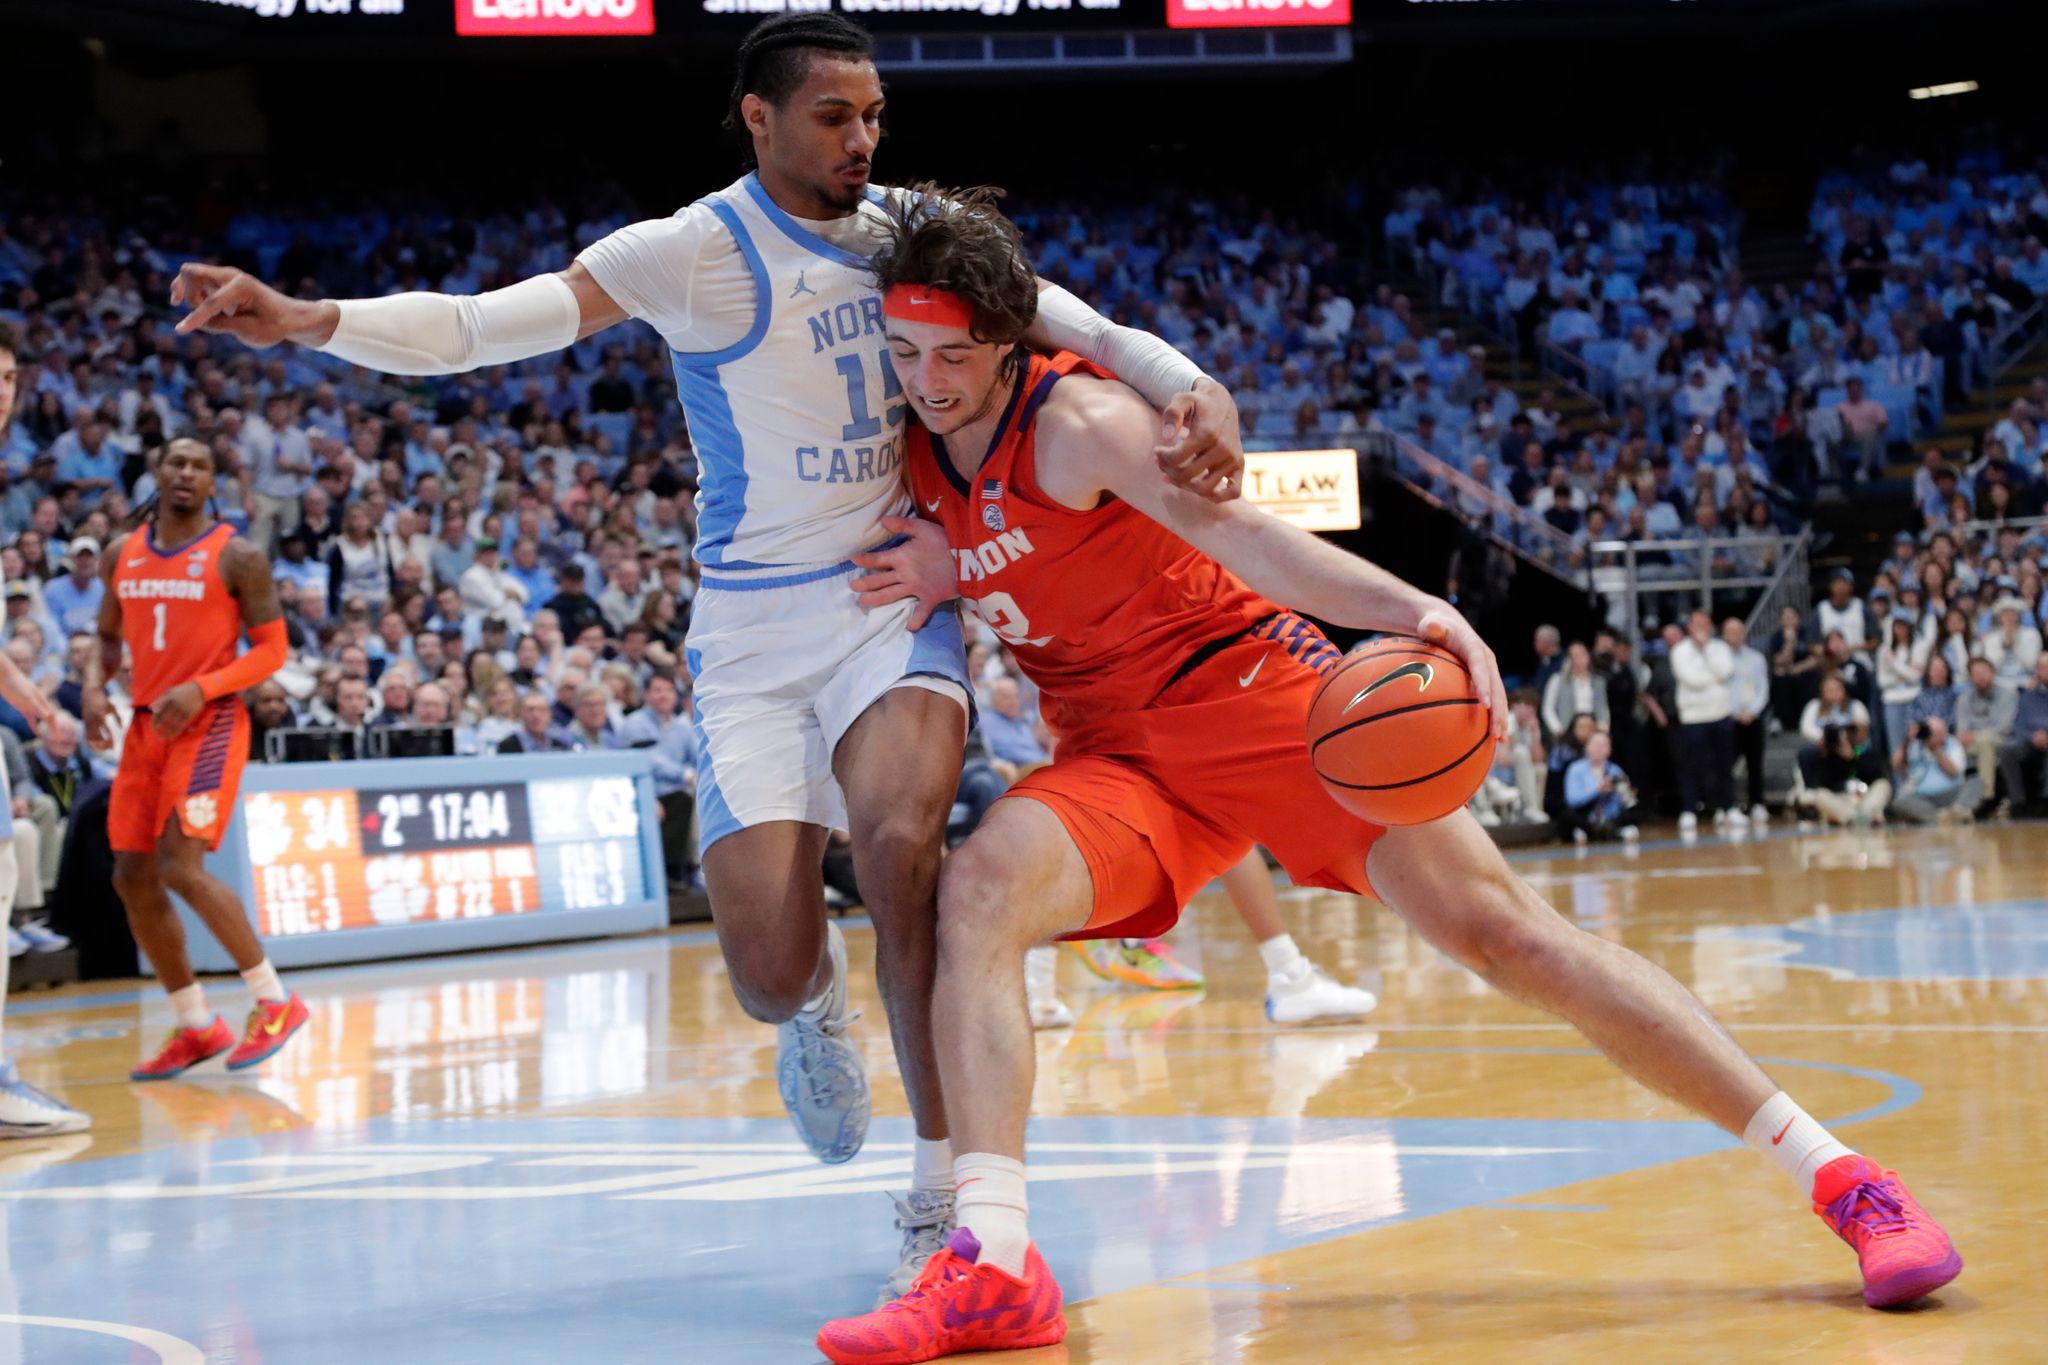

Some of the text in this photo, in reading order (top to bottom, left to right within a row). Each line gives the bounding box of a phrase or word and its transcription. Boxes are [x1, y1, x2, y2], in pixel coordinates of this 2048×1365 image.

[807, 296, 886, 354] NOR
[795, 437, 902, 484] CAROL
[1277, 473, 1340, 496] LAW
[118, 578, 206, 601] CLEMSON
[153, 602, 167, 651] 1
[301, 797, 350, 850] 34
[428, 790, 510, 841] 17:04
